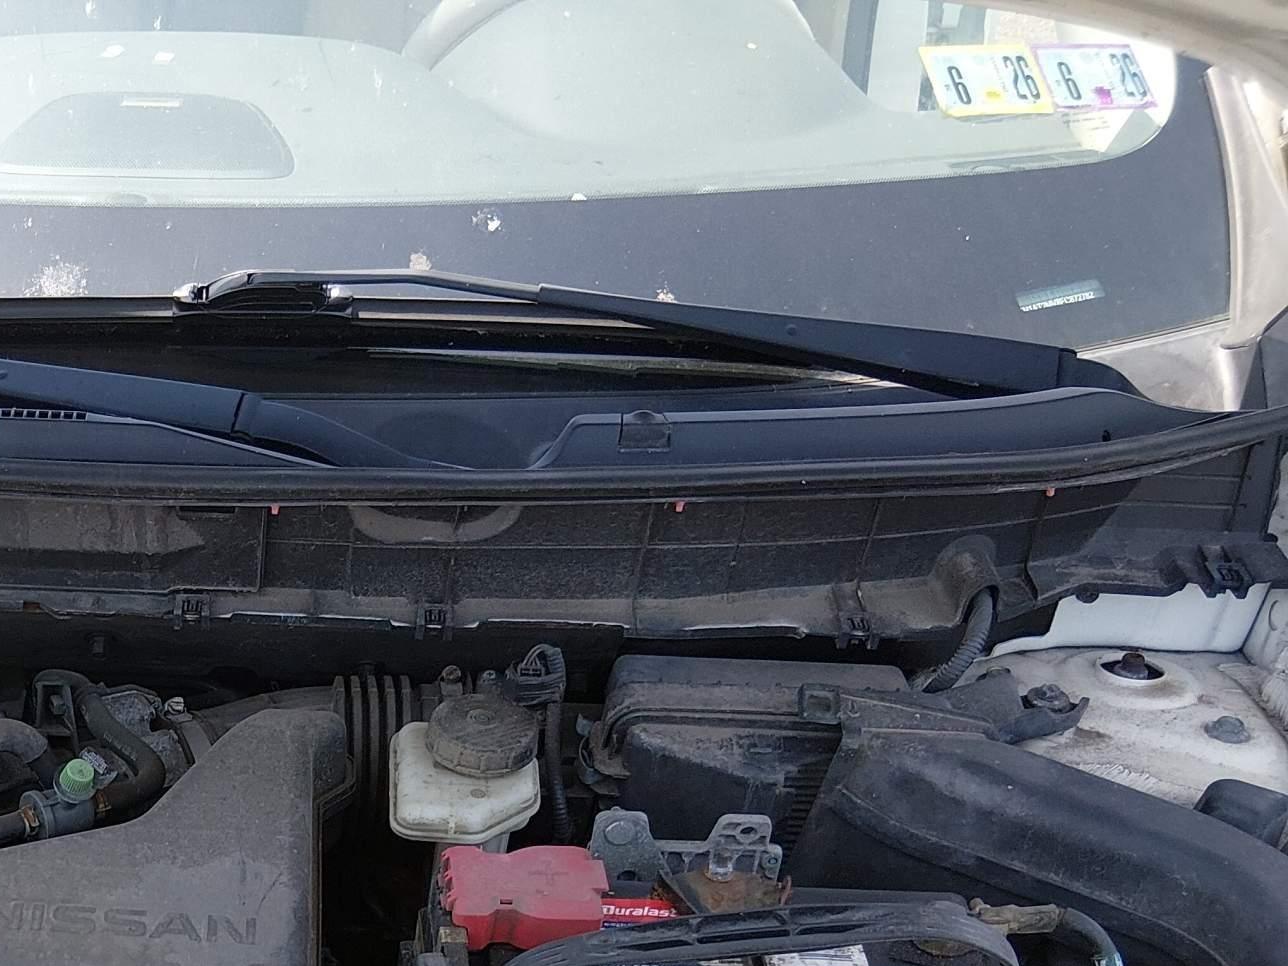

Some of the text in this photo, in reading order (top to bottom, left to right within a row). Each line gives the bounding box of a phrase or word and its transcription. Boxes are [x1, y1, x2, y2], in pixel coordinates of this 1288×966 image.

[947, 55, 1041, 106] 6 26
[1057, 61, 1083, 101] 6
